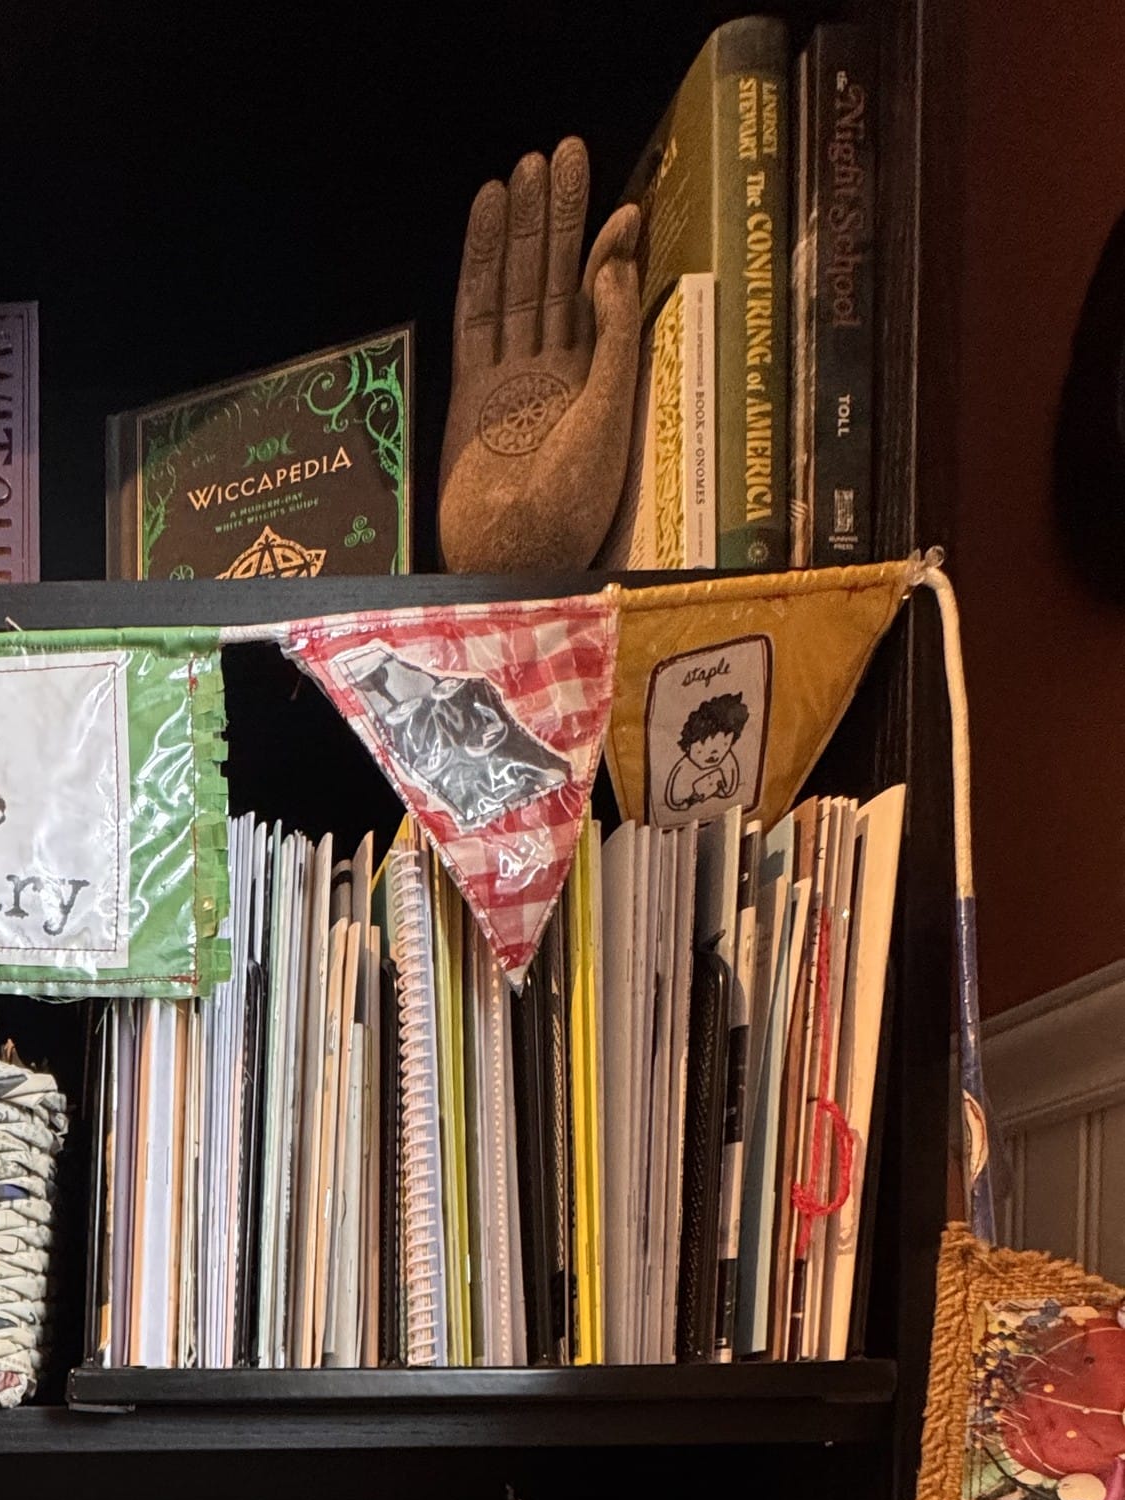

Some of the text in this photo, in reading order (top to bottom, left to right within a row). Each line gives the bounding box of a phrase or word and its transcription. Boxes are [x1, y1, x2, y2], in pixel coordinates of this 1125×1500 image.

[745, 170, 774, 523] The CONJURING of AMERICA
[695, 391, 705, 430] BOOK
[837, 394, 851, 437] TOLL
[186, 445, 354, 512] WICCAPEDIA
[695, 447, 706, 505] GNOMES
[214, 519, 243, 534] WHITE
[246, 507, 286, 525] WITCH'S
[239, 491, 305, 516] MODERN-DAY
[681, 657, 732, 689] staple
